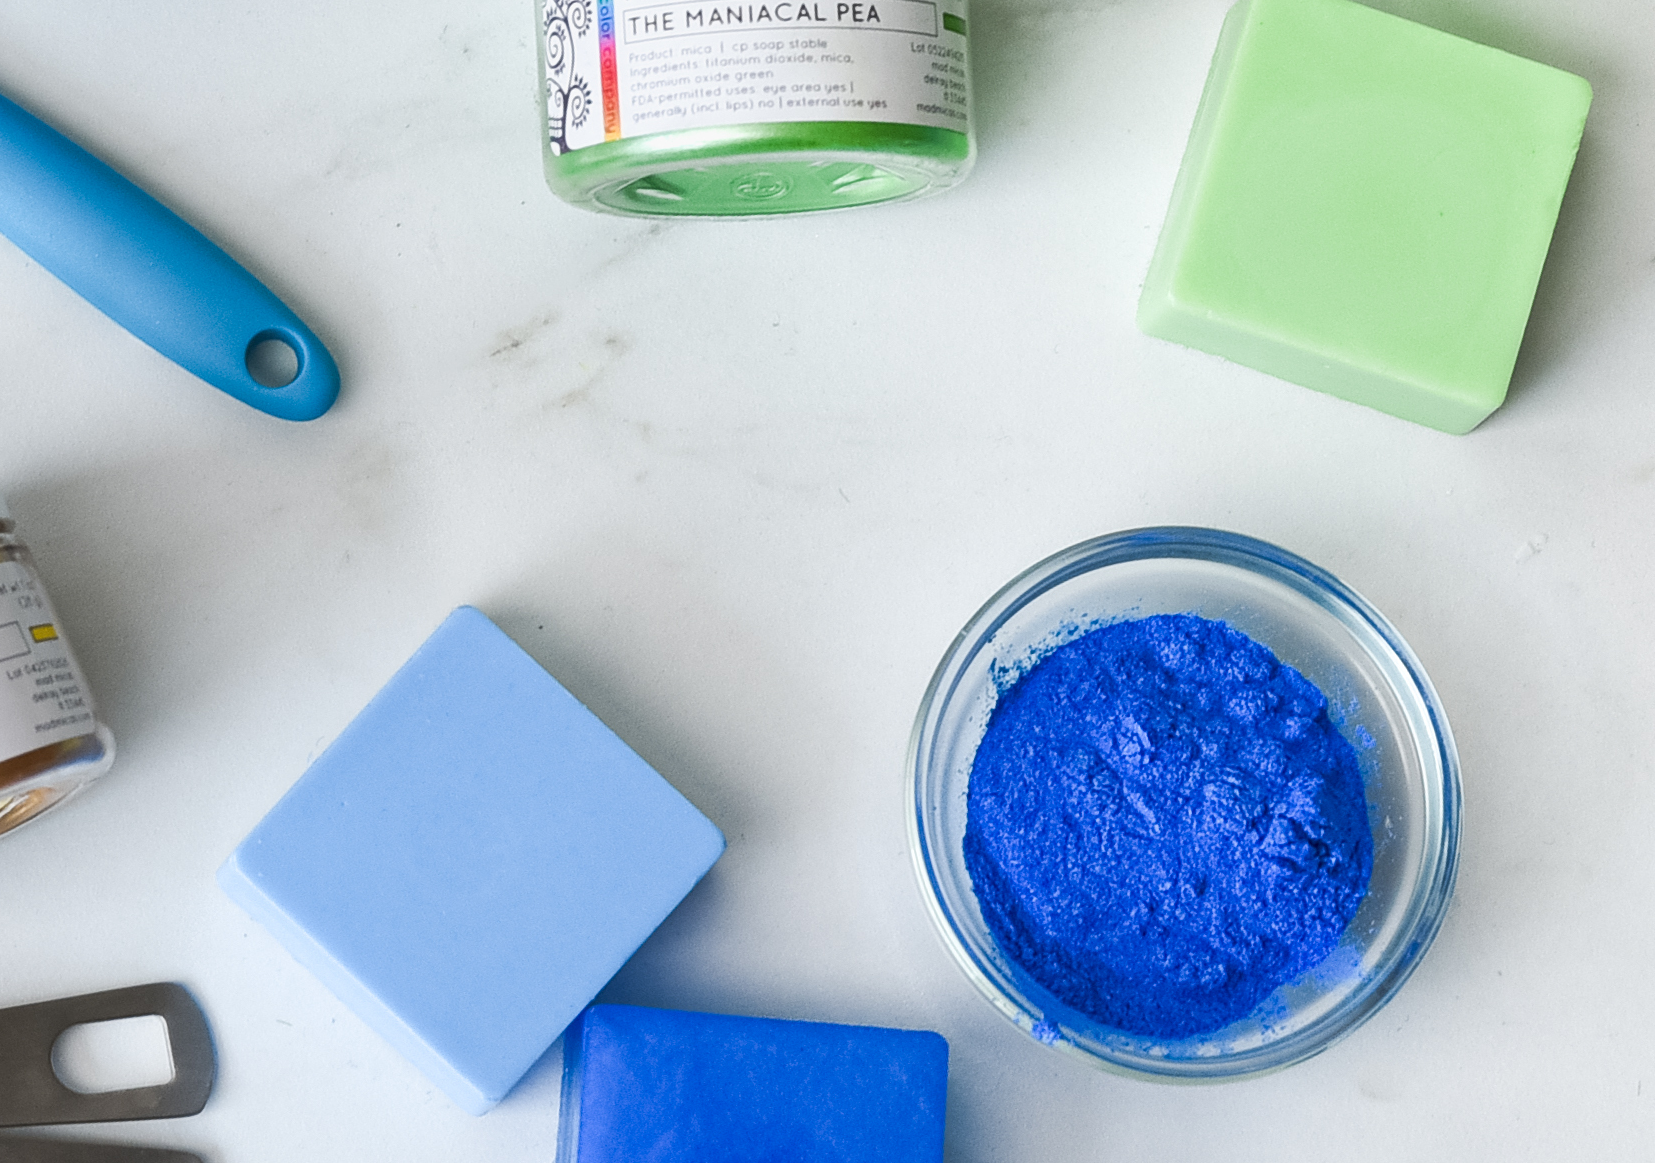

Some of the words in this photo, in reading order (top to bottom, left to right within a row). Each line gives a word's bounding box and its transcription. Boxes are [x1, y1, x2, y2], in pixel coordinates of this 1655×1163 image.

[628, 11, 674, 35] THE
[686, 3, 827, 28] MANIACAL
[837, 3, 881, 23] PEA
[681, 44, 712, 56] mica
[732, 42, 749, 52] cp
[753, 40, 785, 51] soap
[789, 38, 828, 49] stable
[706, 55, 761, 68] titanium
[630, 75, 691, 92] chromium
[695, 71, 730, 84] oxide
[735, 69, 774, 83] green
[763, 84, 787, 95] eye
[791, 83, 822, 93] area
[825, 83, 847, 95] yes
[632, 106, 687, 123] generally
[758, 99, 775, 109] no
[786, 96, 840, 108] external
[843, 99, 865, 108] use
[868, 99, 888, 111] yes
